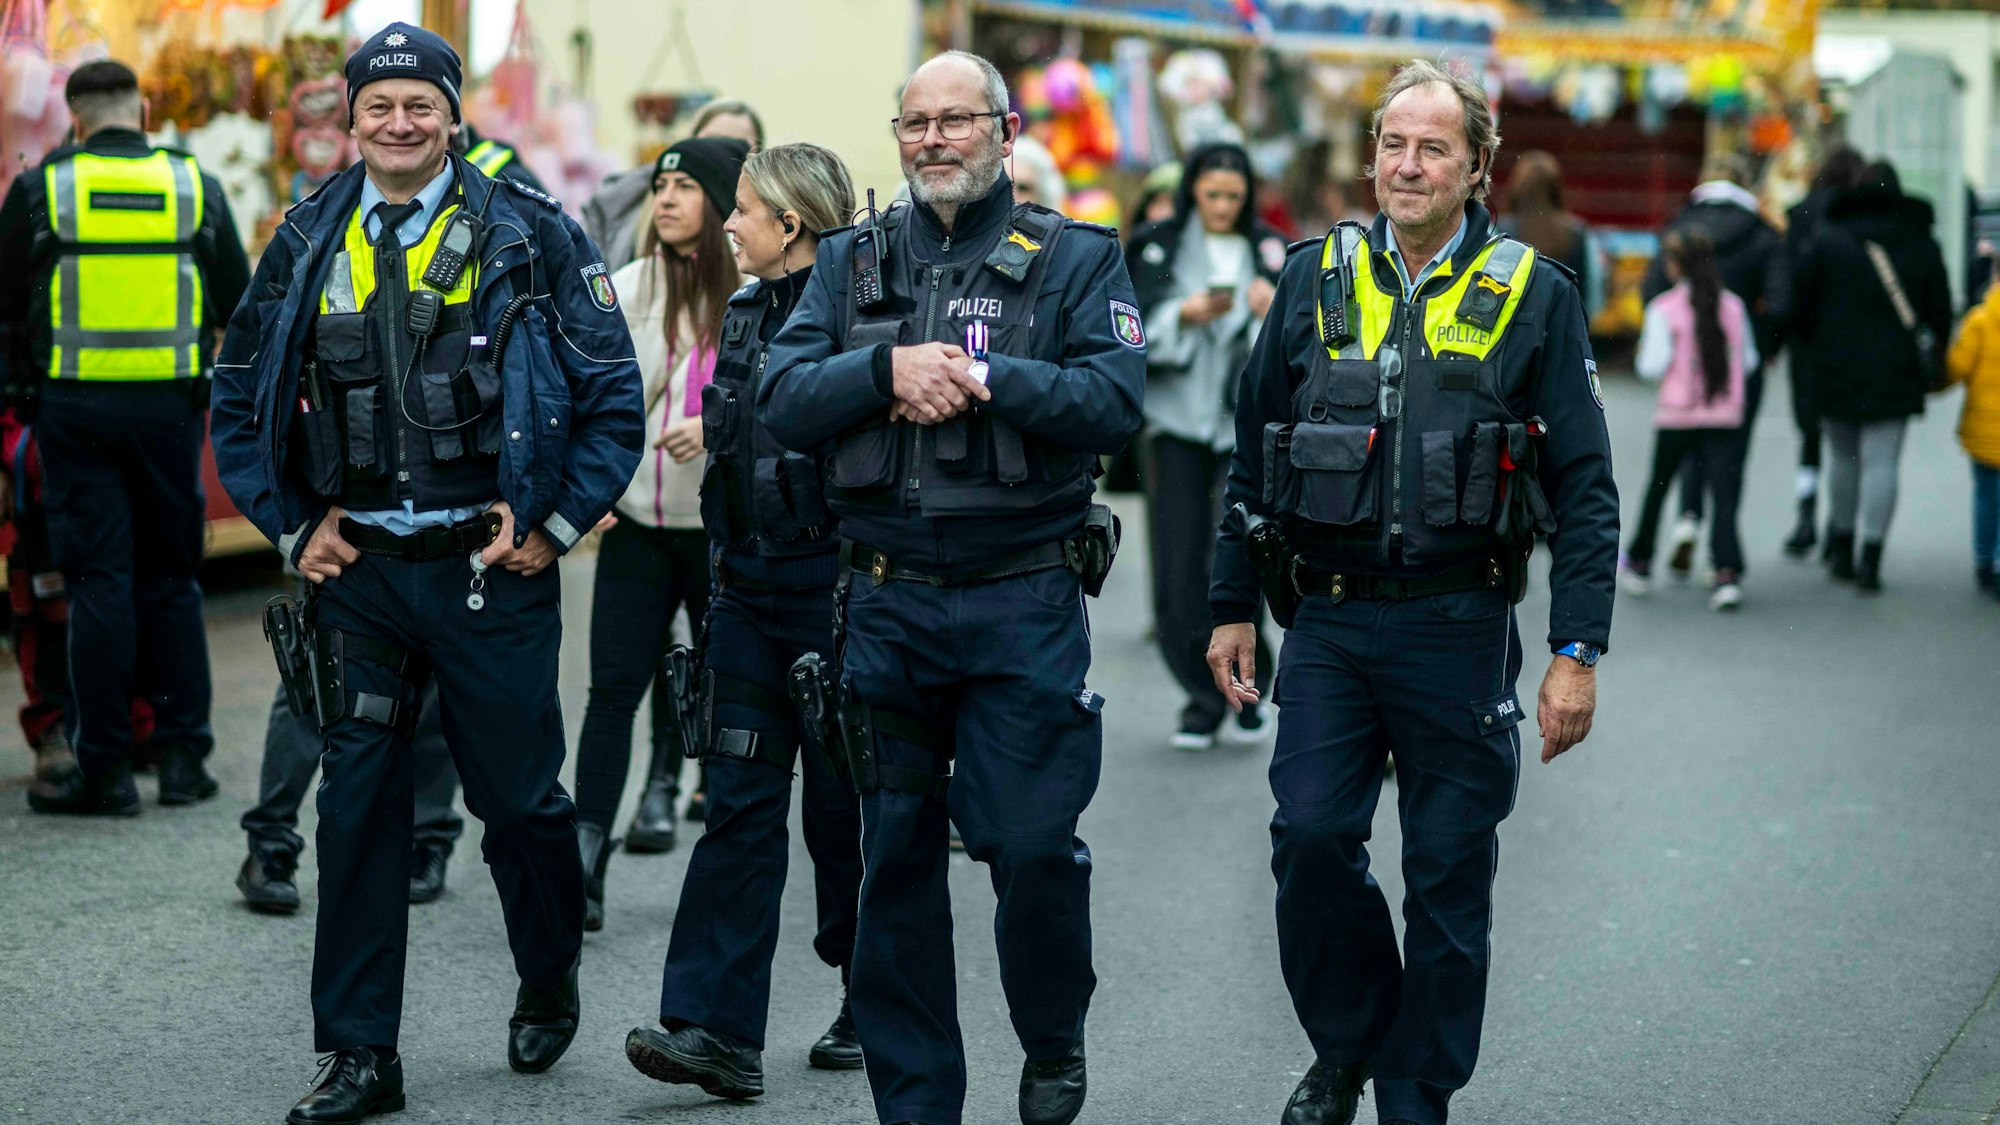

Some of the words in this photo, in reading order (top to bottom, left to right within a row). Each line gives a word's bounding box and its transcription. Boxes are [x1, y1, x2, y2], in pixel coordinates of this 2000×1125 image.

[369, 53, 417, 71] POLIZEI
[947, 297, 1003, 318] POLIZEI
[1437, 325, 1492, 346] POLIZEI
